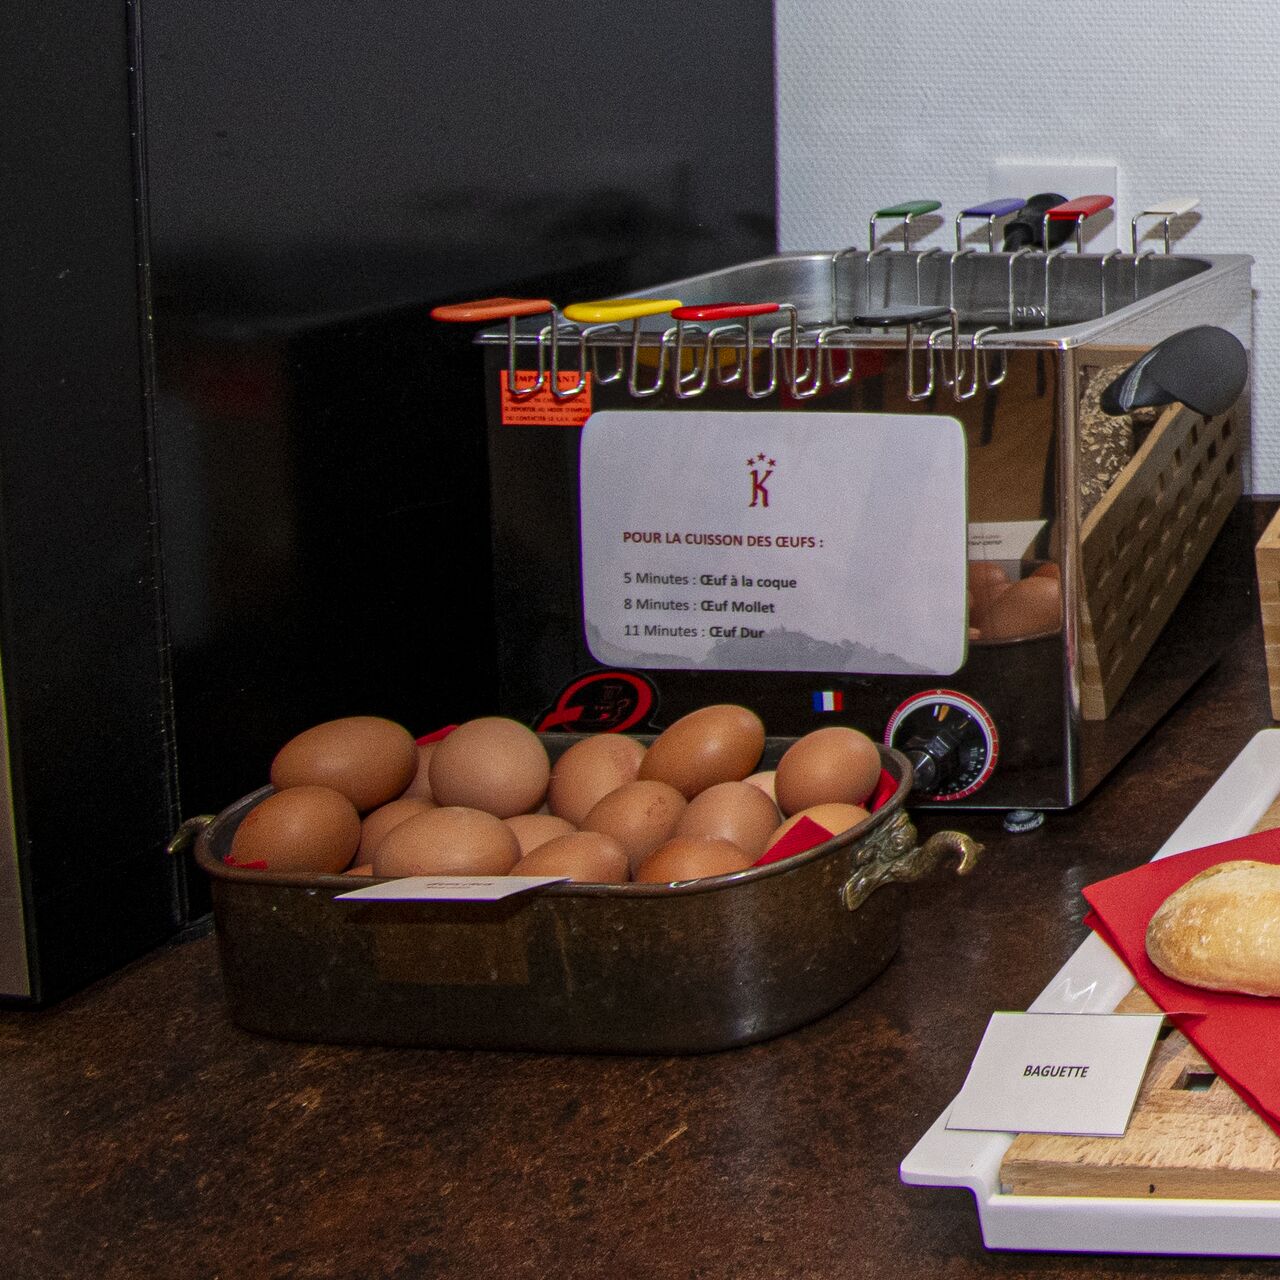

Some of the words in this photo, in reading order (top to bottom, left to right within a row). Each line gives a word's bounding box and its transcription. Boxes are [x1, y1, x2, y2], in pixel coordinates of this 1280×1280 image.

[623, 531, 662, 544] POUR
[665, 532, 682, 545] LA
[685, 533, 743, 547] CUISSON
[747, 535, 772, 548] DES
[775, 535, 816, 548] ŒUFS
[623, 572, 632, 584] 5
[636, 572, 689, 586] Minutes
[700, 574, 728, 587] Œuf
[730, 574, 738, 587] à
[741, 575, 753, 588] la
[757, 578, 797, 591] coque
[624, 598, 632, 610] 8
[636, 598, 690, 611] Minutes
[700, 600, 728, 612] Œuf
[731, 600, 775, 613] Mollet
[624, 625, 640, 637] 11
[644, 625, 698, 638] Minutes
[708, 626, 737, 638] Œuf
[740, 627, 765, 639] Dur
[1023, 1065, 1090, 1079] BAGUETTE
